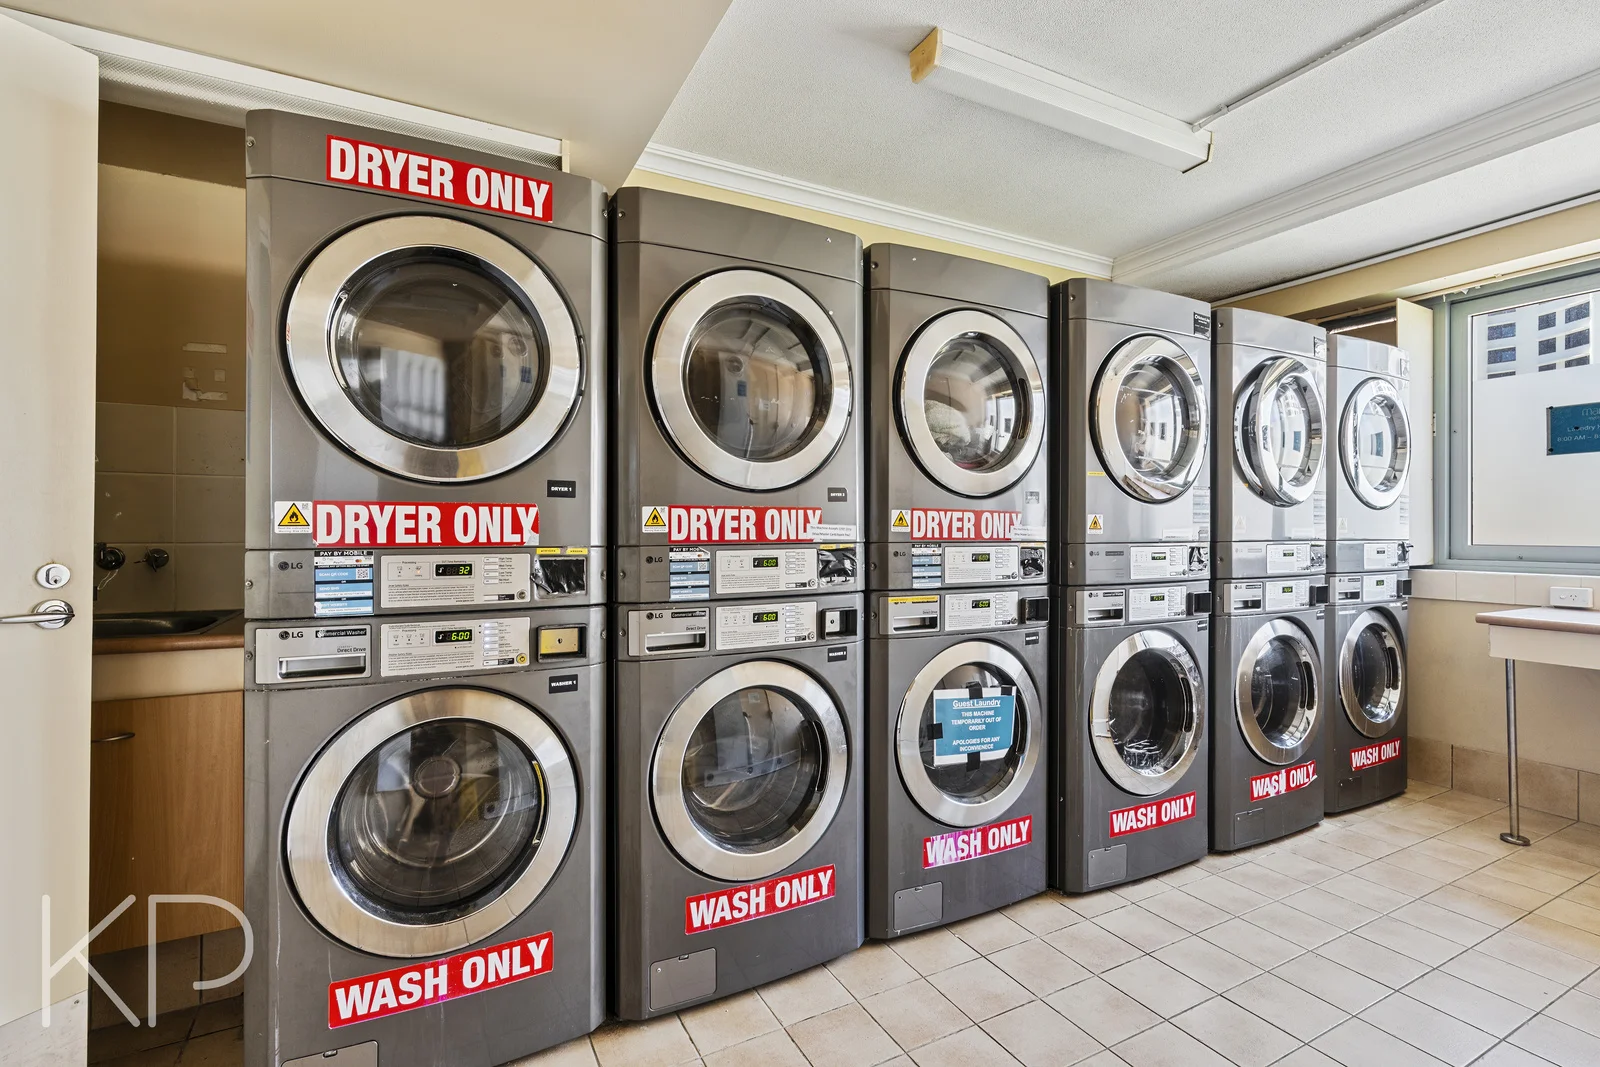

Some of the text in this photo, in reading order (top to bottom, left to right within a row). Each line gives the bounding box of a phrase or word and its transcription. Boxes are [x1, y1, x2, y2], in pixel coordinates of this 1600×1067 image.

[330, 139, 550, 218] DRYER ONLY
[317, 505, 538, 544] DRYER ONLY
[670, 508, 822, 541] DRYER ONLY
[913, 510, 1022, 538] DRYER ONLY
[459, 566, 470, 575] 32
[975, 699, 1001, 707] Laundry
[1352, 742, 1400, 767] WASH ONLY
[1290, 763, 1314, 788] ONLY
[1112, 795, 1194, 833] WASH ONLY
[926, 819, 1030, 864] WASH ONLY
[690, 869, 833, 928] WASH ONLY
[335, 937, 549, 1020] WASH ONLY
